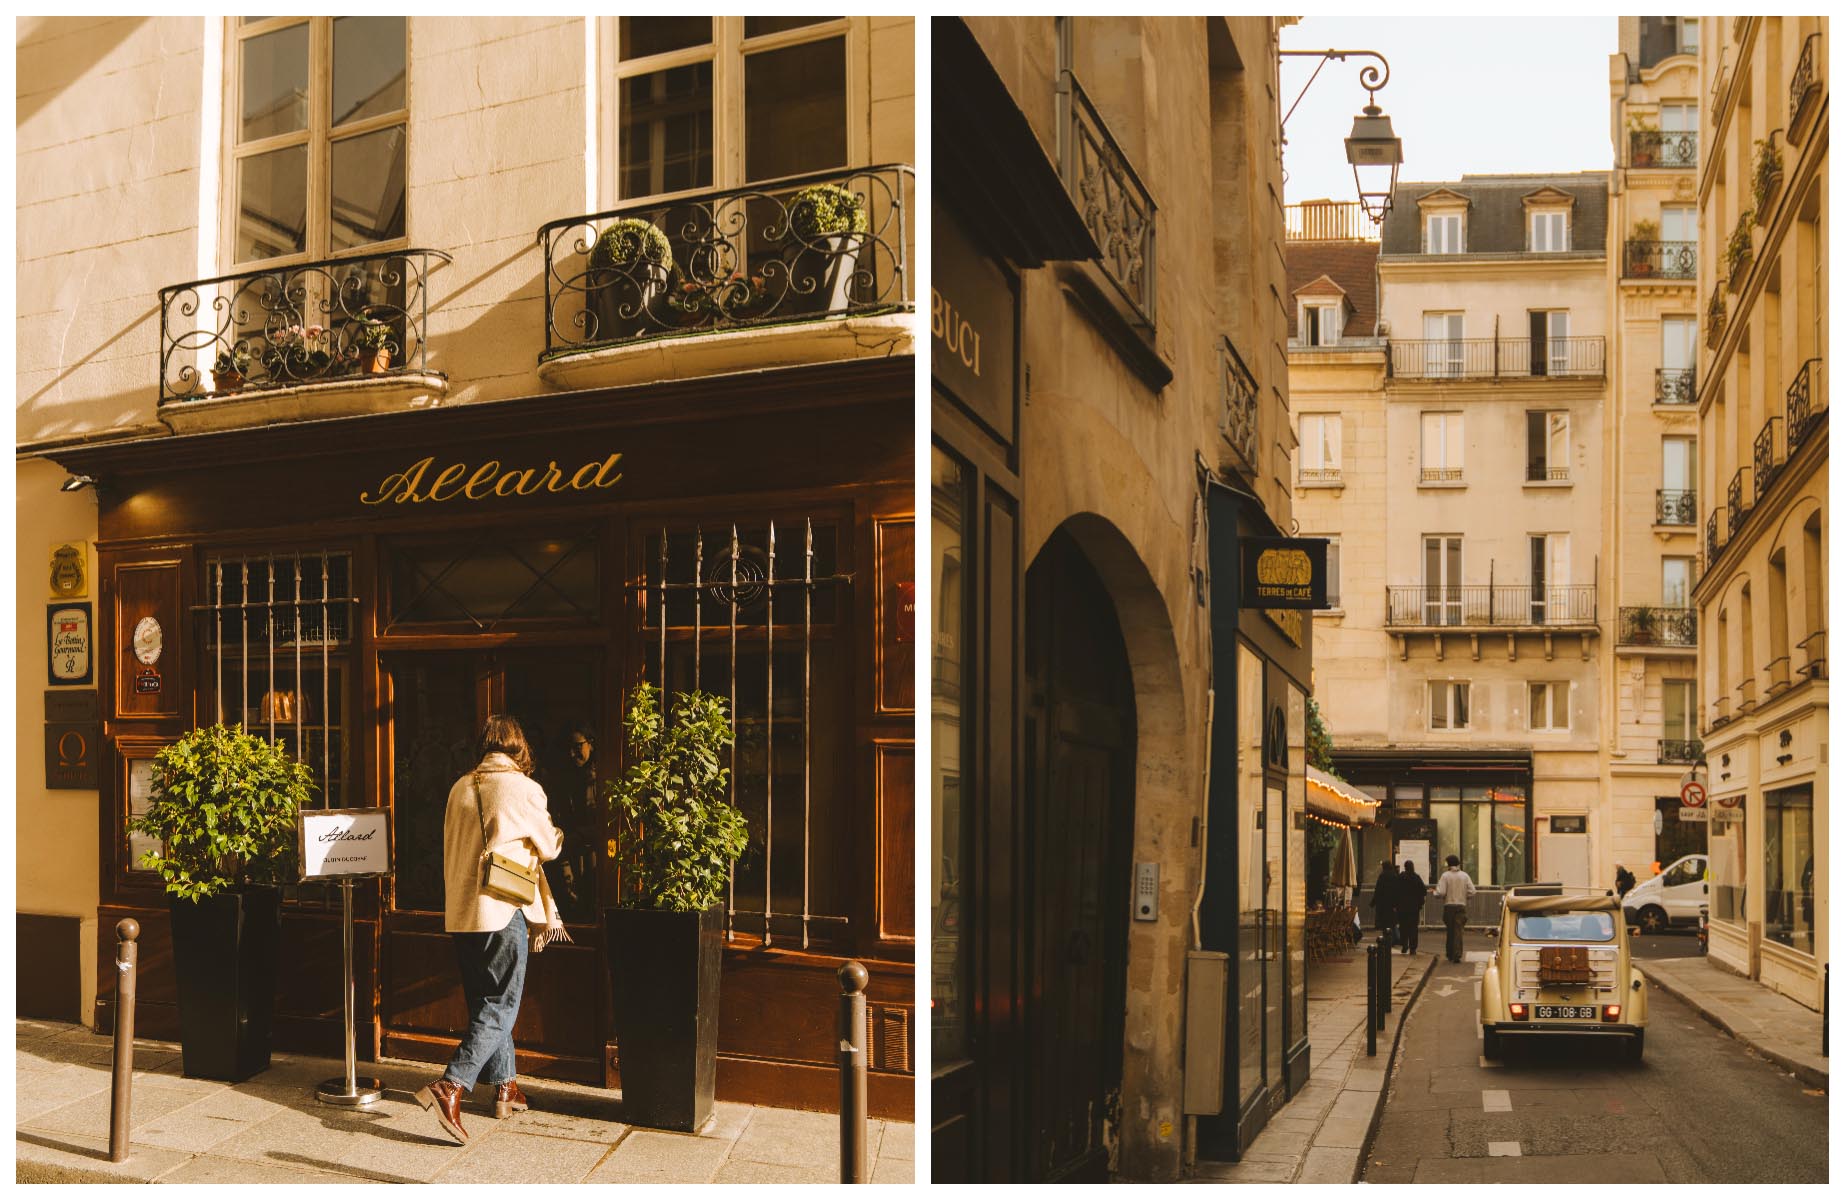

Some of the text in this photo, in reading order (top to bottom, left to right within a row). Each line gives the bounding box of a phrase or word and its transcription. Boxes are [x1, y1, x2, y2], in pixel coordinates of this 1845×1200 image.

[931, 286, 980, 377] BUCI
[360, 453, 623, 505] Allard
[1257, 587, 1285, 597] TERRES
[1293, 585, 1312, 597] CAFÉ
[318, 826, 376, 842] Allard
[1517, 988, 1526, 1000] F
